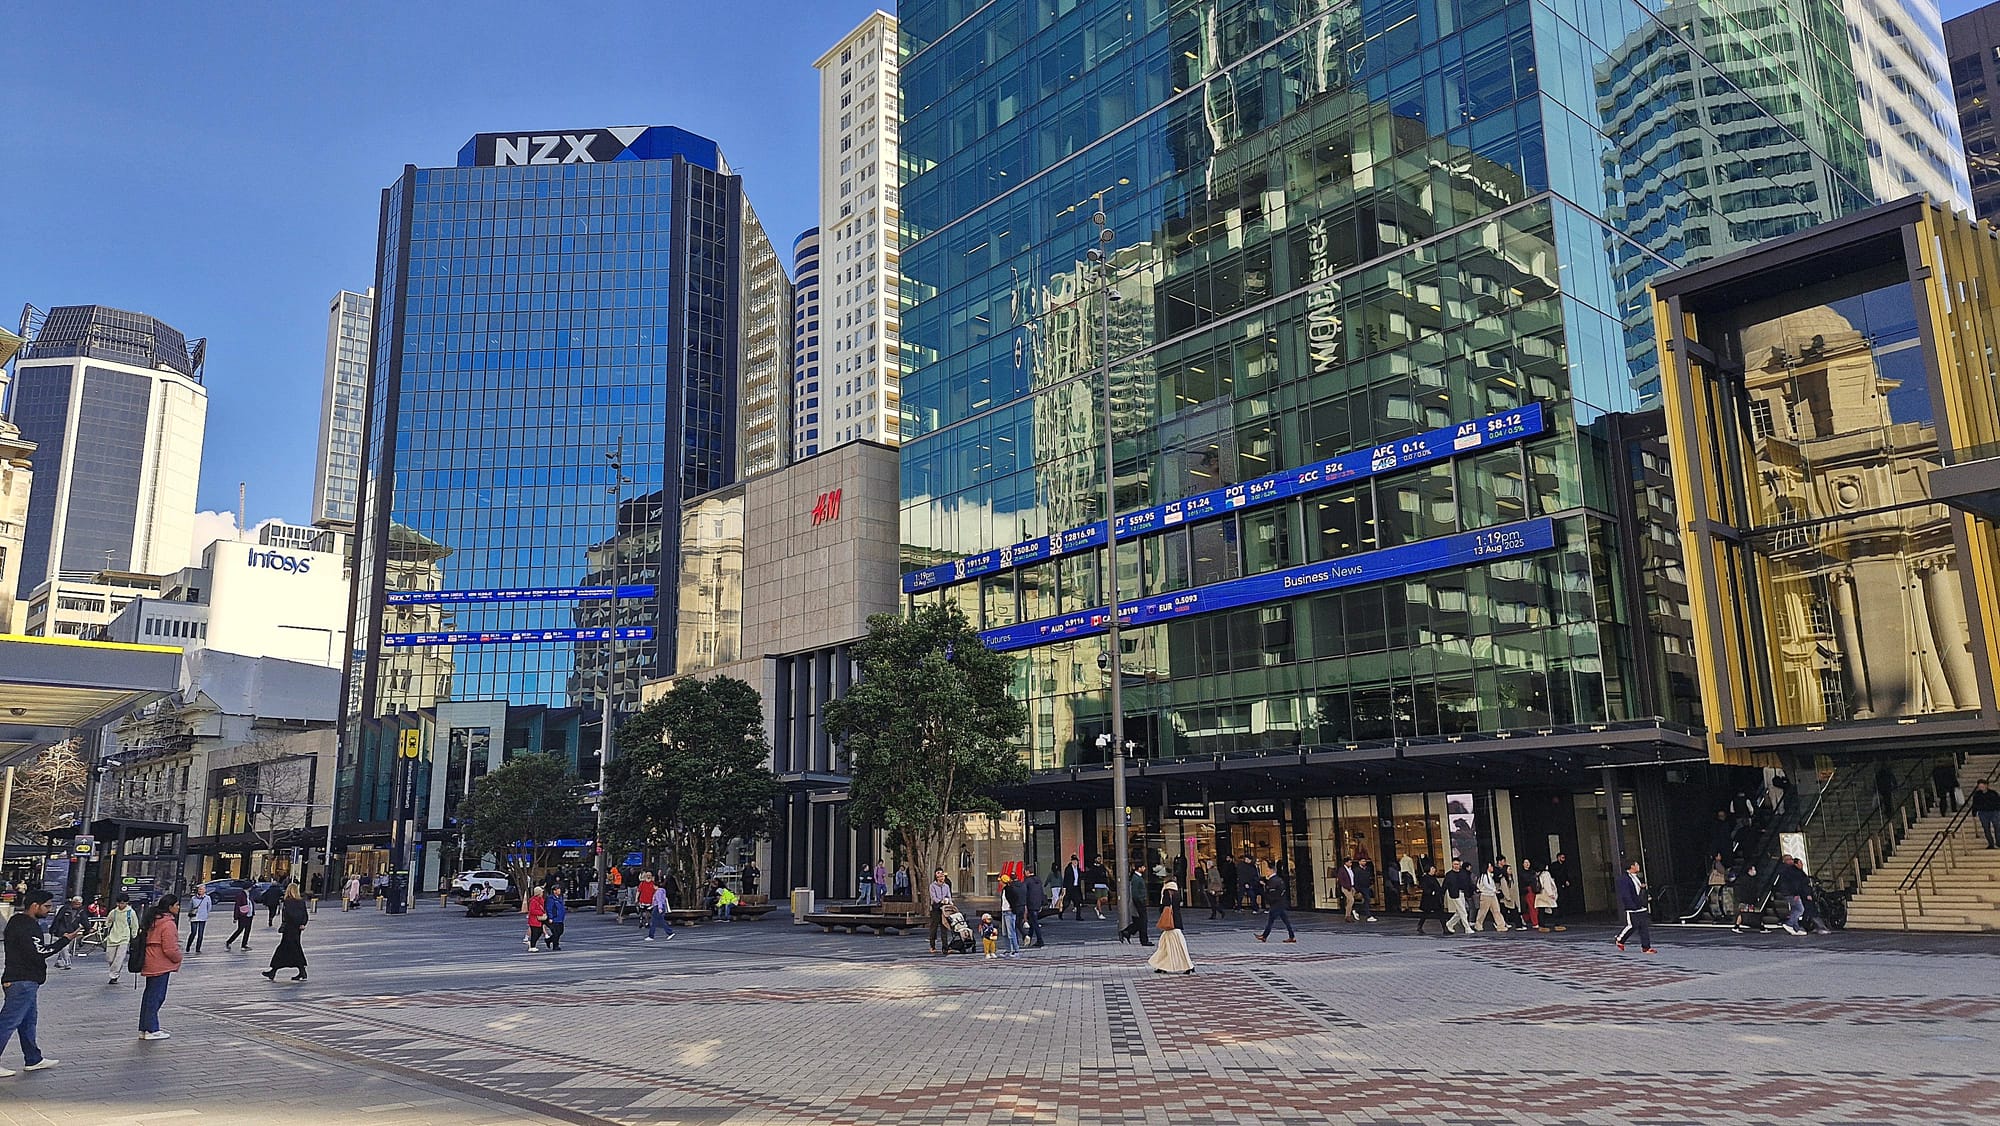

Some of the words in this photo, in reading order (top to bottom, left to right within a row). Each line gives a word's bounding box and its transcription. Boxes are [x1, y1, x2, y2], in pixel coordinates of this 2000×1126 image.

[495, 134, 597, 166] NZX
[1457, 422, 1477, 437] AFI
[1487, 414, 1521, 432] $8.12
[1489, 431, 1503, 440] 0.04
[1507, 425, 1524, 435] 0.5%
[1372, 444, 1395, 459] AFC
[1402, 440, 1425, 453] 0.1¢
[1298, 470, 1319, 484] 2CC
[1325, 463, 1343, 474] 52¢
[1225, 485, 1245, 497] POT
[1250, 480, 1275, 494] $6.97
[811, 488, 842, 526] H&M
[1165, 502, 1181, 513] PCT
[1187, 497, 1210, 511] $1.24
[1116, 517, 1125, 527] FT
[1129, 512, 1155, 526] $59.95
[1050, 538, 1063, 550] 50
[1476, 530, 1520, 546] 1:19pm
[1473, 546, 1483, 556] 13
[1485, 545, 1502, 554] Aug
[1504, 538, 1525, 550] 2025
[248, 547, 311, 575] Infosys
[1000, 551, 1012, 562] 20
[914, 571, 935, 582] 1:19pm
[955, 563, 965, 576] 10
[1284, 572, 1329, 588] Business
[1331, 564, 1363, 578] News
[1158, 602, 1173, 612] EUR
[1102, 615, 1111, 623] CA
[1051, 624, 1064, 633] AUD
[986, 634, 1011, 645] Futures
[1174, 808, 1204, 817] COACH
[1230, 804, 1274, 815] COACH
